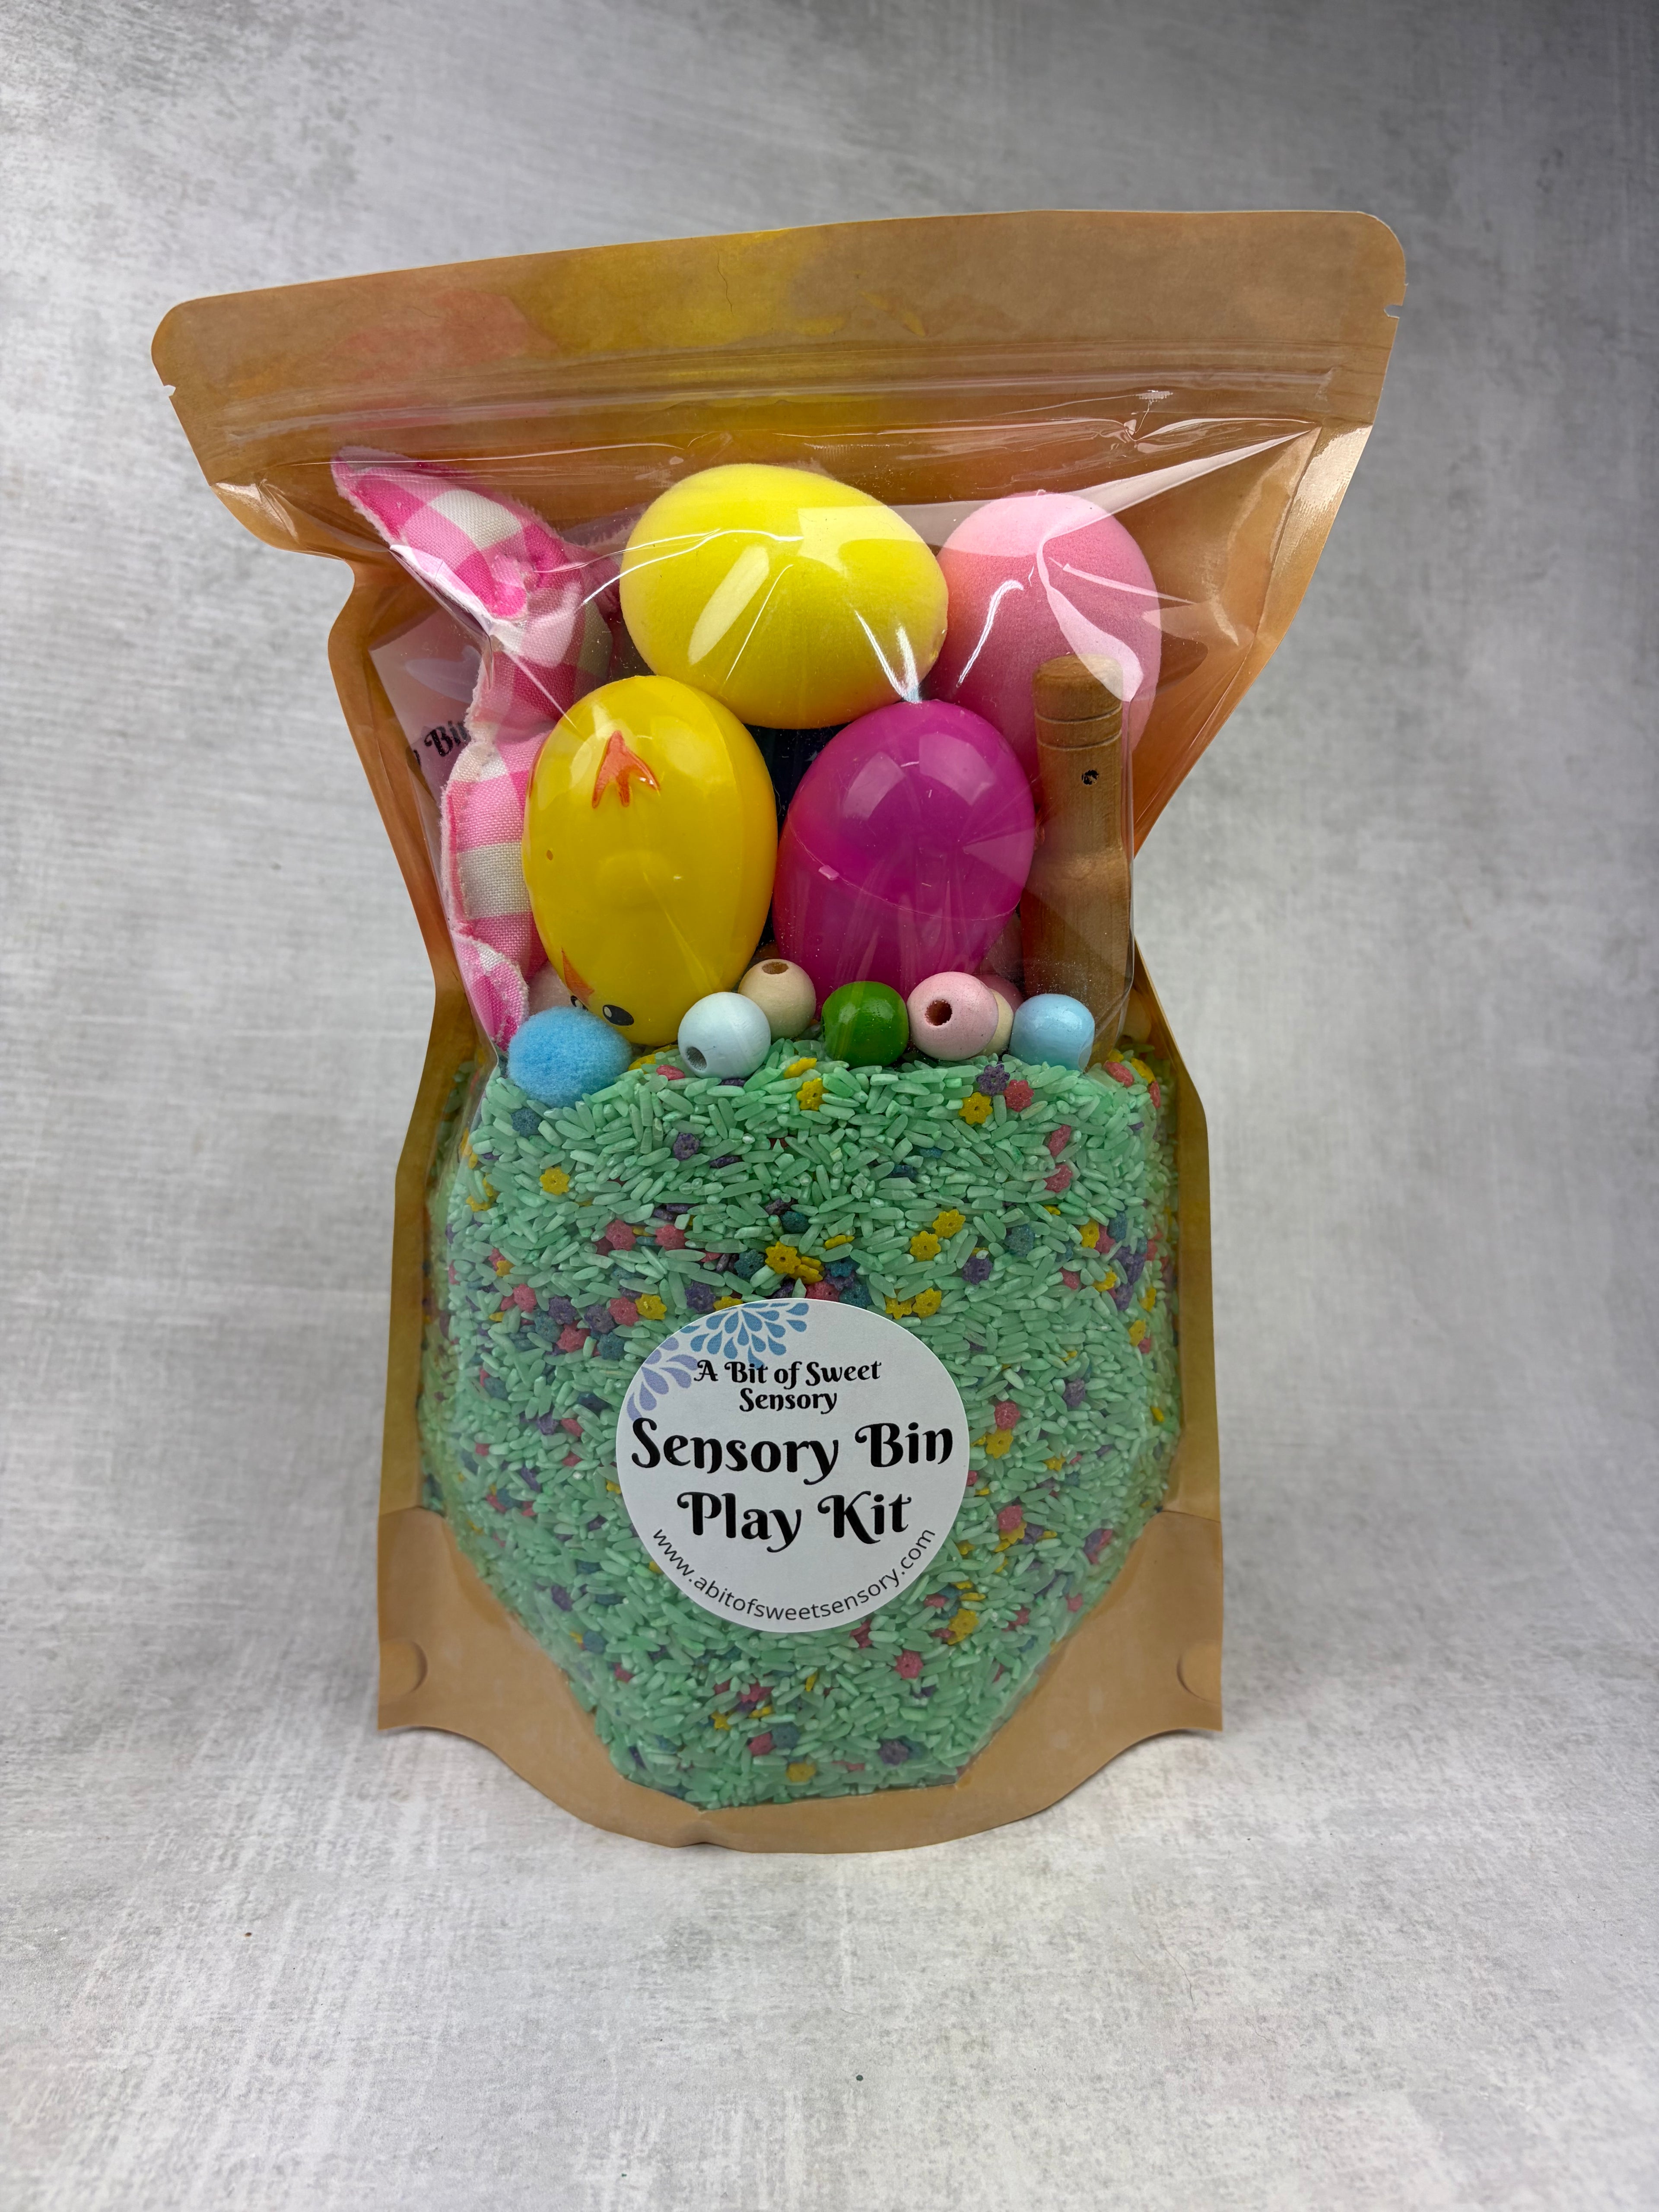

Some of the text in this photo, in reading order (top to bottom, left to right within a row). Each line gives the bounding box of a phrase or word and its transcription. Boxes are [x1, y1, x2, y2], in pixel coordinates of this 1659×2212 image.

[693, 1359, 882, 1390] A Bit of Sweet
[739, 1388, 837, 1414] Sensory
[631, 1417, 953, 1485] Sensory Bin
[677, 1491, 912, 1553] Play Kit
[653, 1528, 936, 1621] www.abitofsweetsensory.com
